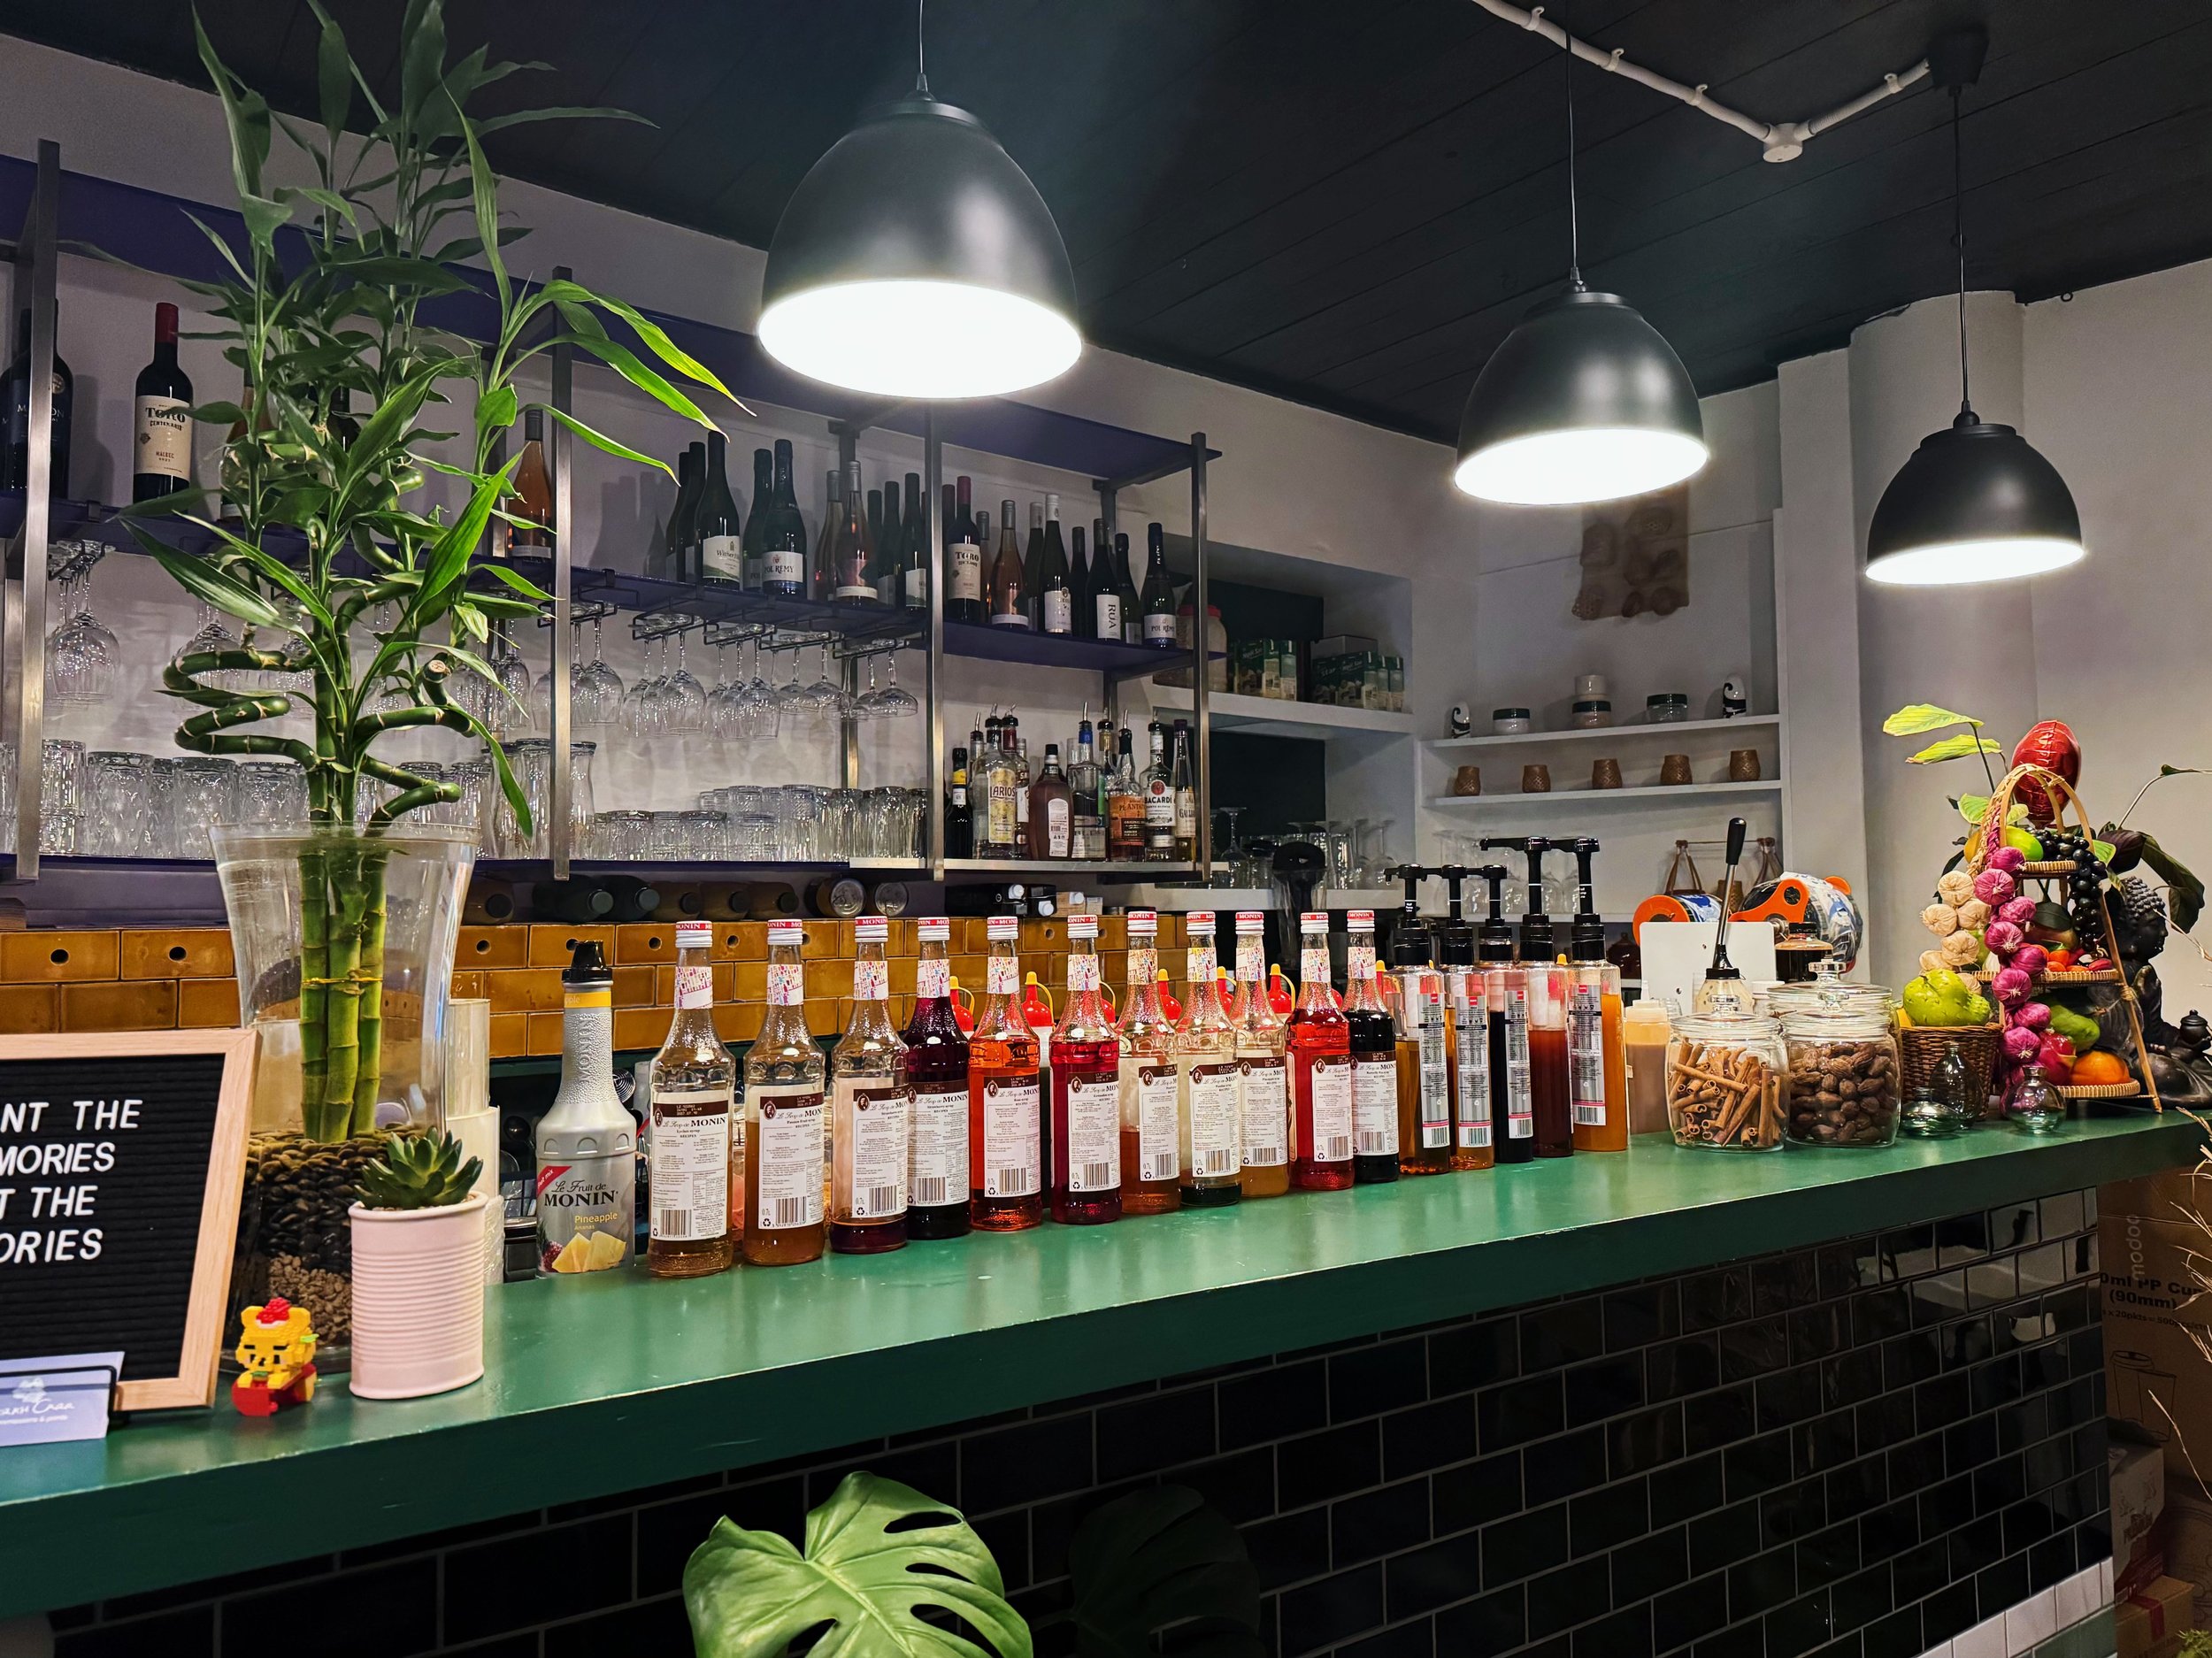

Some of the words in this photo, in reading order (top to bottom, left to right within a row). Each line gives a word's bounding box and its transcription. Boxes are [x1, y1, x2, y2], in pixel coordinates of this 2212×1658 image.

[1108, 603, 1117, 629] RUA
[990, 786, 1016, 798] LARIOS
[0, 1102, 50, 1133] NT
[73, 1099, 143, 1131] THE
[690, 1117, 726, 1127] MONIN
[551, 1180, 566, 1193] Le
[566, 1179, 594, 1193] Fruit
[30, 1185, 98, 1218] THE
[544, 1190, 616, 1208] MONIN
[574, 1212, 618, 1224] Pineapple
[2138, 1278, 2162, 1290] PP
[2109, 1288, 2177, 1310] (90mm)
